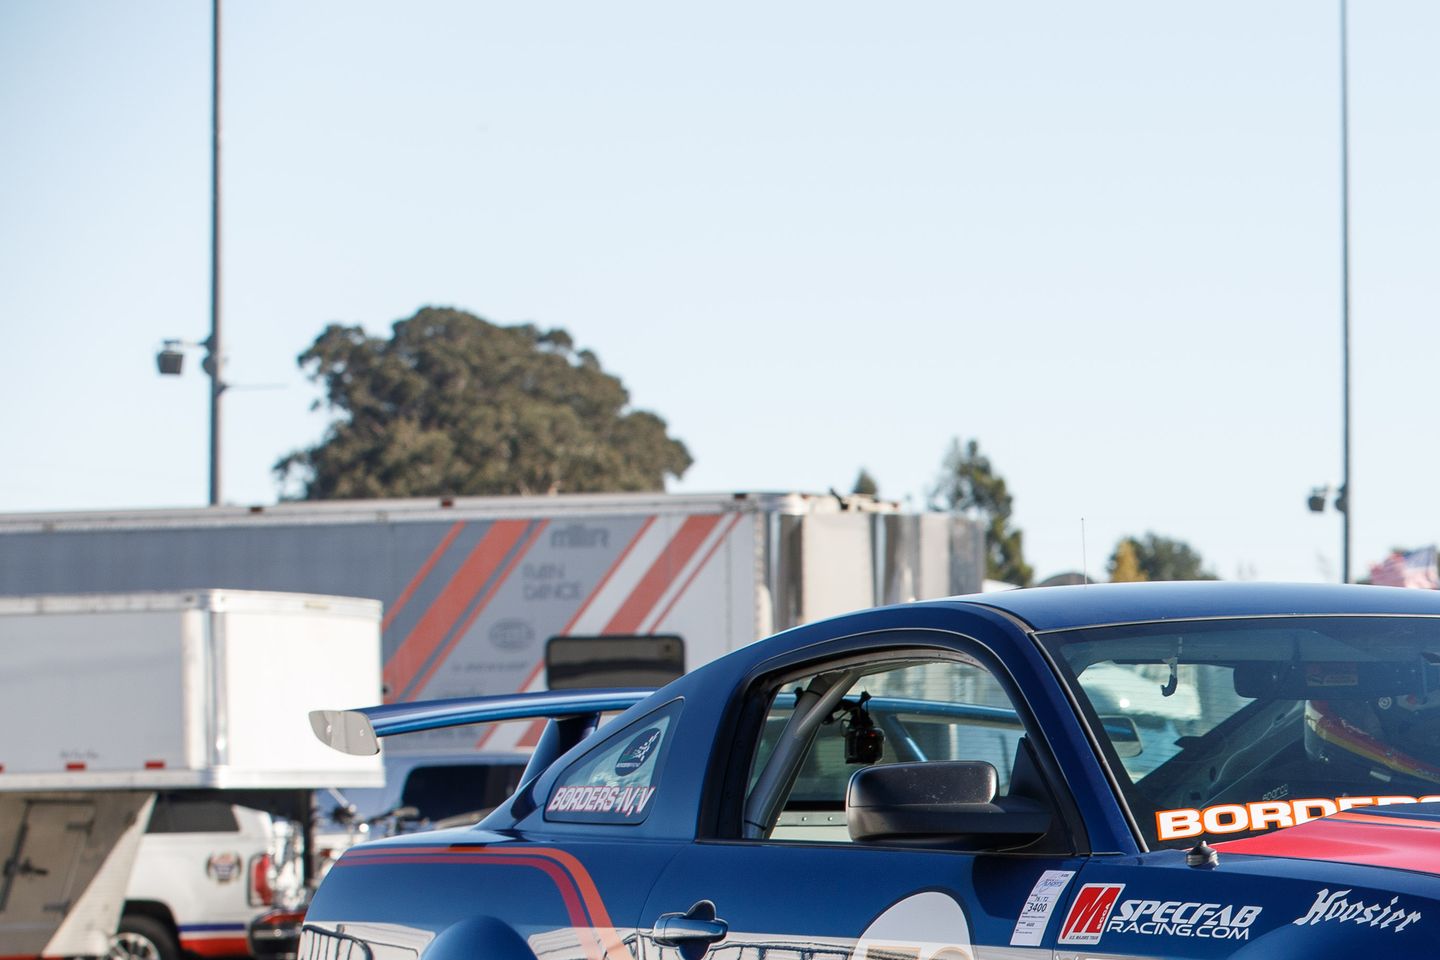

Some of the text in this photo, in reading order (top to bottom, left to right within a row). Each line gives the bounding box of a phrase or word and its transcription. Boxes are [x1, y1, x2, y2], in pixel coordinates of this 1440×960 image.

[547, 786, 620, 812] BORDERS
[1027, 903, 1047, 912] 3400
[1096, 903, 1111, 930] SCCA
[1112, 900, 1263, 928] SPECFAB
[1292, 888, 1422, 933] Hoosier
[1107, 920, 1249, 940] RACING.COM
